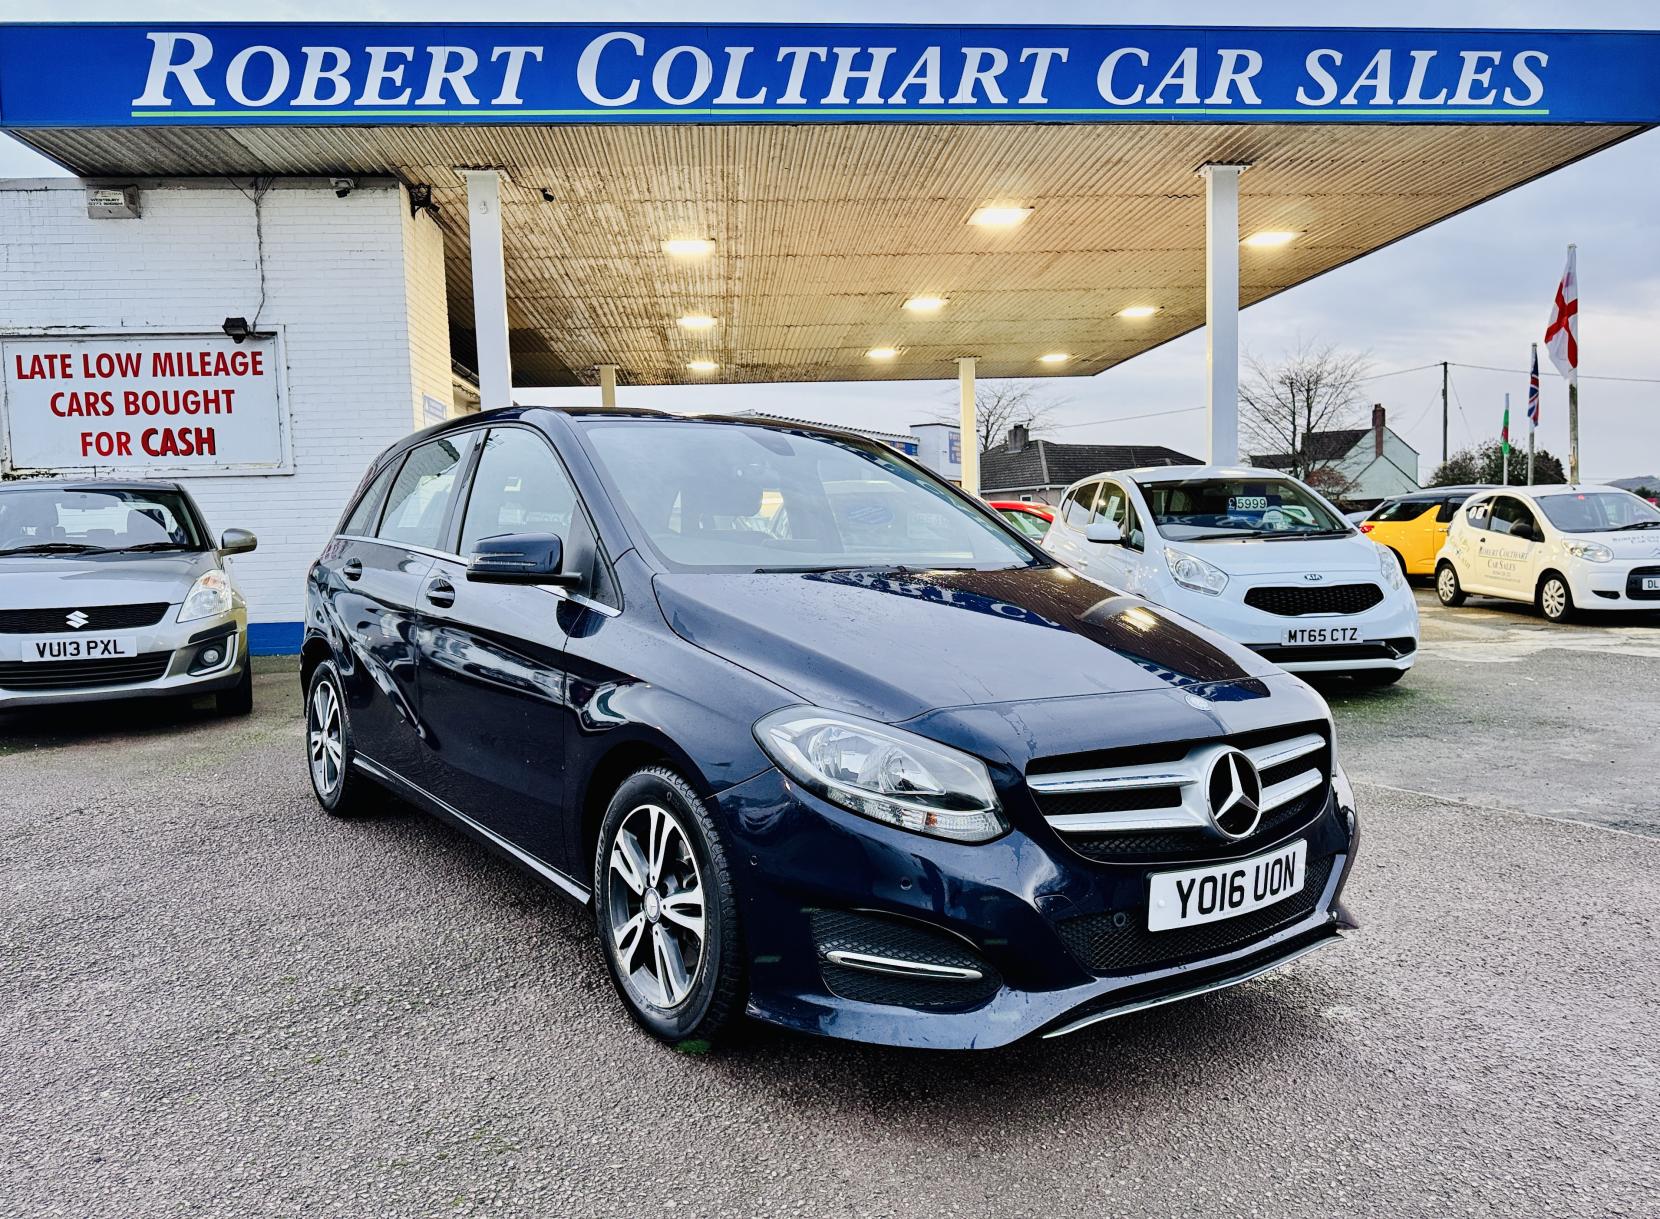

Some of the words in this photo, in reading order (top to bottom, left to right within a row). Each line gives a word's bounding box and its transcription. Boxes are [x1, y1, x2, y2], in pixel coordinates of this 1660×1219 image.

[132, 32, 543, 107] ROBERT
[577, 31, 1068, 107] COLTHART
[1097, 47, 1262, 106] CAR
[1296, 48, 1549, 107] SALES
[16, 353, 73, 380] LATE
[82, 353, 142, 379] LOW
[152, 350, 263, 378] MILEAGE
[50, 391, 115, 418] CARS
[123, 389, 235, 417] BOUGHT
[81, 431, 132, 457] FOR
[141, 427, 216, 457] CASH
[1228, 497, 1267, 510] £5999
[1304, 573, 1323, 581] KIA
[36, 641, 81, 658] VU13
[86, 639, 125, 656] PXL
[1288, 628, 1327, 643] MT65
[1331, 627, 1358, 642] CTZ
[1176, 869, 1246, 919] YO16
[1253, 851, 1296, 902] UON
